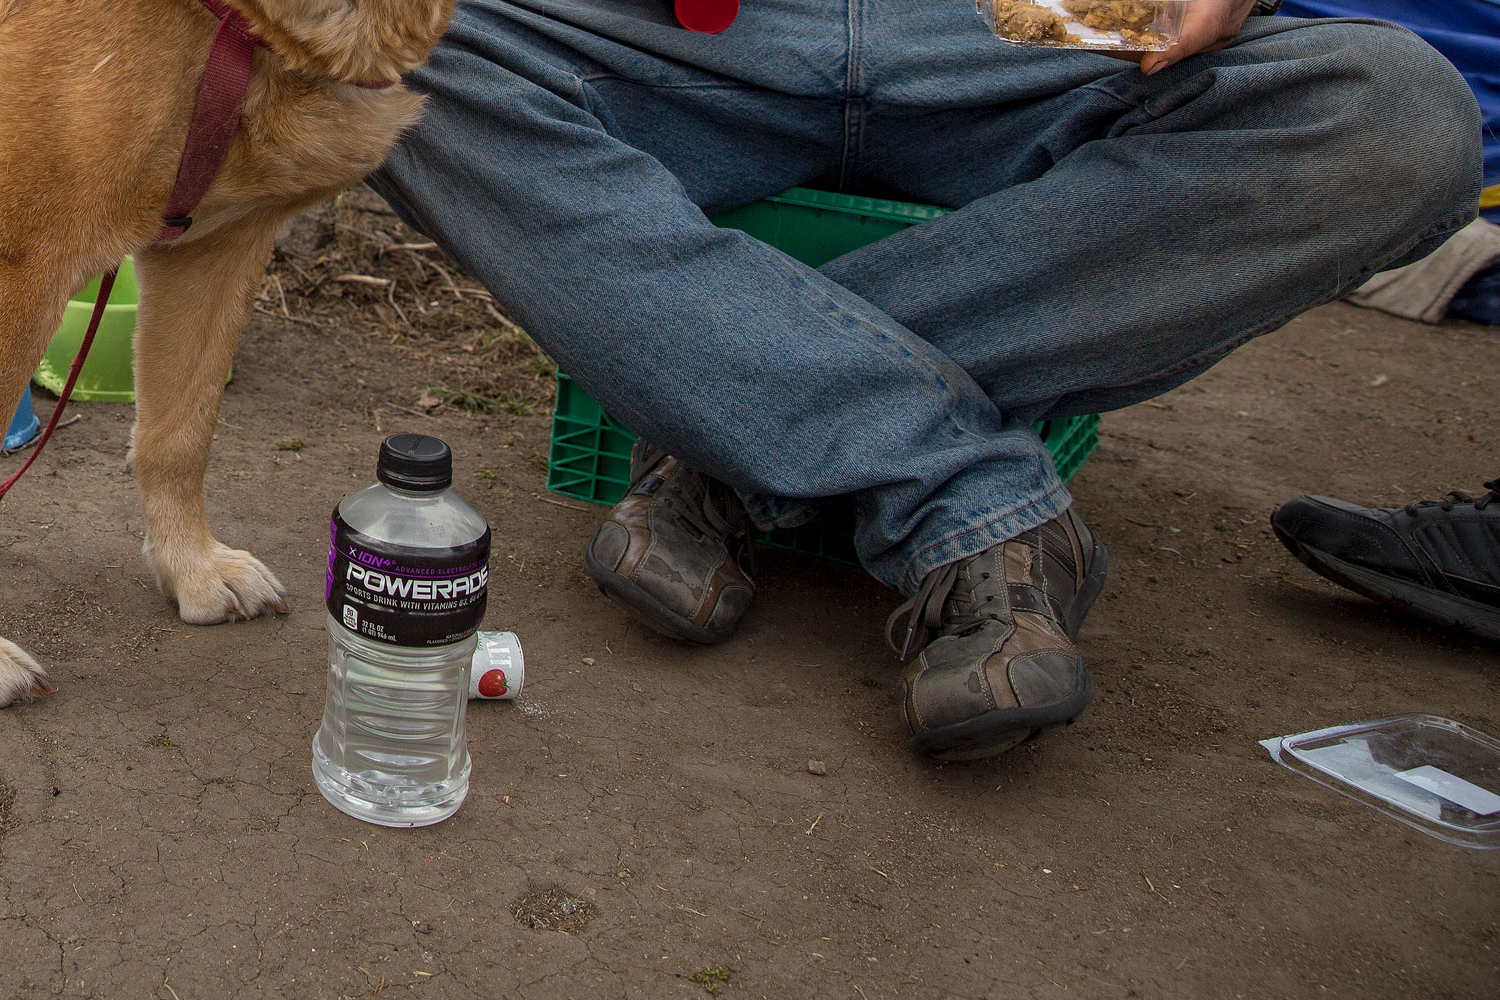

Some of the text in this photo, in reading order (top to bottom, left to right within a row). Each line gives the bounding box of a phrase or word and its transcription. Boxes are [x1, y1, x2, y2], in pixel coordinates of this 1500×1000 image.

[346, 561, 488, 600] POWERADE
[395, 566, 435, 575] ADVANCED
[345, 582, 371, 600] SPORTS
[373, 594, 398, 608] DRINK
[400, 600, 421, 610] WITH
[423, 600, 458, 611] VITAMINS
[361, 619, 369, 628] 32
[369, 622, 376, 631] FL
[376, 624, 384, 633] OZ
